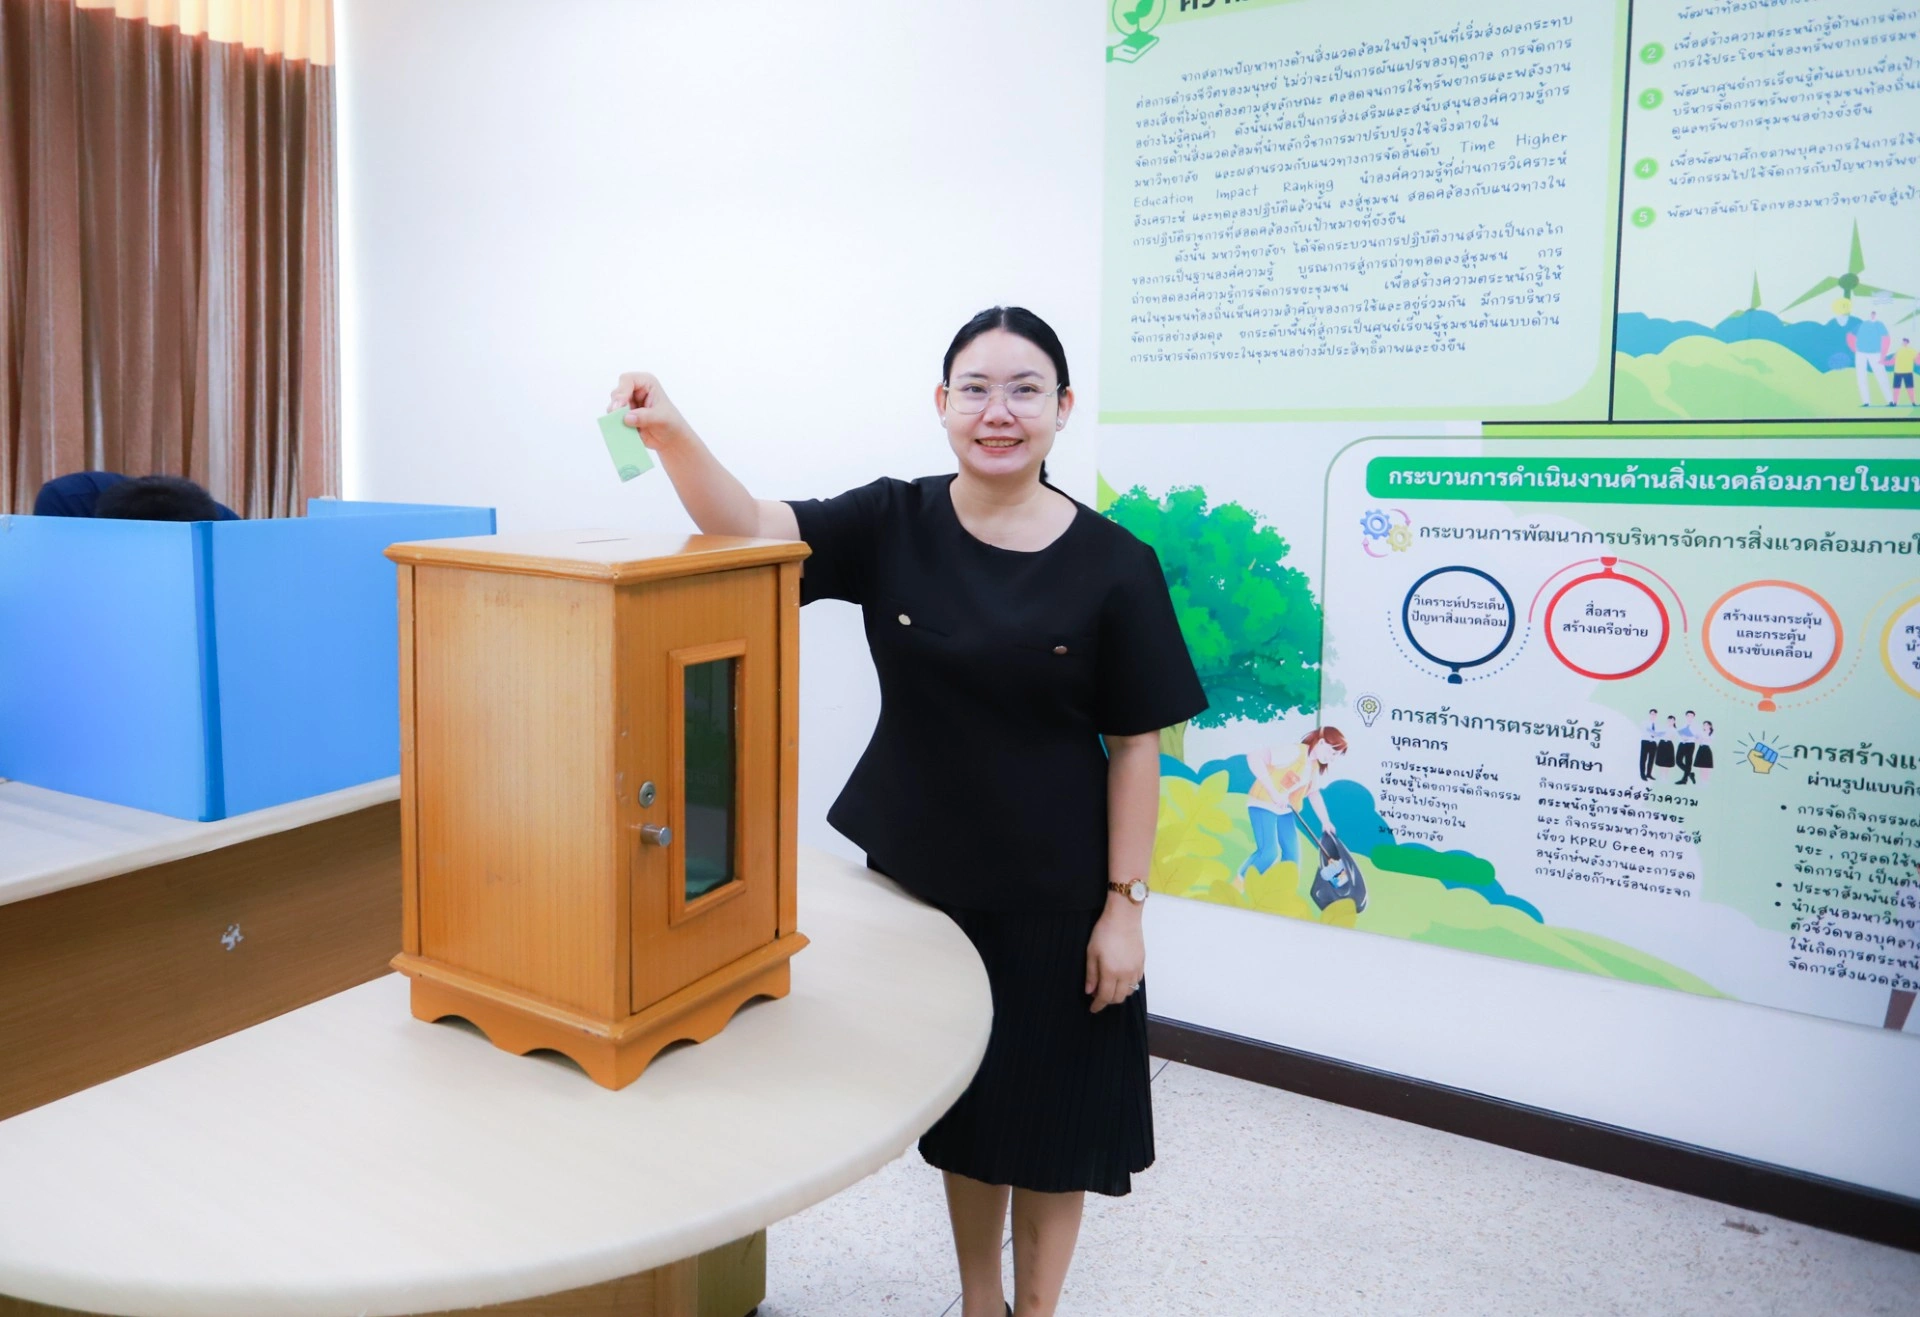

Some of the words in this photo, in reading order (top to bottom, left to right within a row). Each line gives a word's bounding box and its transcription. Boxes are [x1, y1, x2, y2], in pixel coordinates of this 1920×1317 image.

[1674, 8, 1920, 51] เพื่อสร้างความตระหนักรู้ด้านการจัดก
[1501, 38, 1573, 58] การจัดการ
[1134, 169, 1199, 188] มหาวิทยาลัย
[1460, 139, 1496, 153] Time
[1516, 132, 1568, 150] Higher
[1133, 193, 1194, 208] Education
[1215, 184, 1259, 201] Impact
[1283, 179, 1335, 193] Ranking
[1133, 211, 1185, 228] สังเคราะห์
[1175, 243, 1206, 263] ดังนั้น
[1538, 247, 1563, 259] การ
[1480, 289, 1561, 307] มีการบริหาร
[1130, 329, 1223, 346] จัดการอย่างสมดุล
[1413, 594, 1505, 612] วิเคราะห์ประเด็น
[1585, 600, 1627, 619] สื่อสาร
[1411, 608, 1507, 628] ปัญหาสิ่งแวดล้อม
[1562, 619, 1649, 638] สร้างเครือข่าย
[1723, 608, 1822, 629] สร้างแรงกระตุ้น
[1736, 628, 1806, 645] และกระตุ้น
[1728, 641, 1813, 660] แรงขับเคลื่อน
[1391, 705, 1604, 749] การสร้างการตระหนักรู้
[1391, 735, 1449, 751] บุคลากร
[1535, 750, 1603, 773] นักศึกษา
[1793, 742, 1920, 770] การสร้างแ
[1381, 761, 1499, 782] การประชุมแลกเปลี่ยน
[1380, 774, 1521, 802] เรียนรู้โดยการจัดกิจกรรม
[1539, 777, 1699, 807] กิจกรรมรณรงค์สร้างความ
[1380, 789, 1458, 814] สัญจรไปยังทุก
[1538, 797, 1685, 824] ตระหนักรู้การจัดการขยะ
[1379, 807, 1466, 829] หน่วยงานภายใน
[1378, 824, 1444, 842] มหาวิทยาลัย
[1537, 815, 1560, 825] และ
[1565, 815, 1702, 845] กิจกรรมมหาวิทยาลัยสี
[1536, 829, 1566, 844] เขียว
[1570, 834, 1607, 849] KPRU
[1612, 840, 1655, 858] Green
[1659, 849, 1684, 860] การ
[1536, 848, 1696, 881] อนุรักษ์พลังงานและการลด
[1794, 859, 1862, 880] จัดการน้ำ
[1535, 866, 1691, 898] การปล่อยก๊าซเรือนกระจก
[1792, 881, 1920, 909] ประชาสัมพันธ์เชิ
